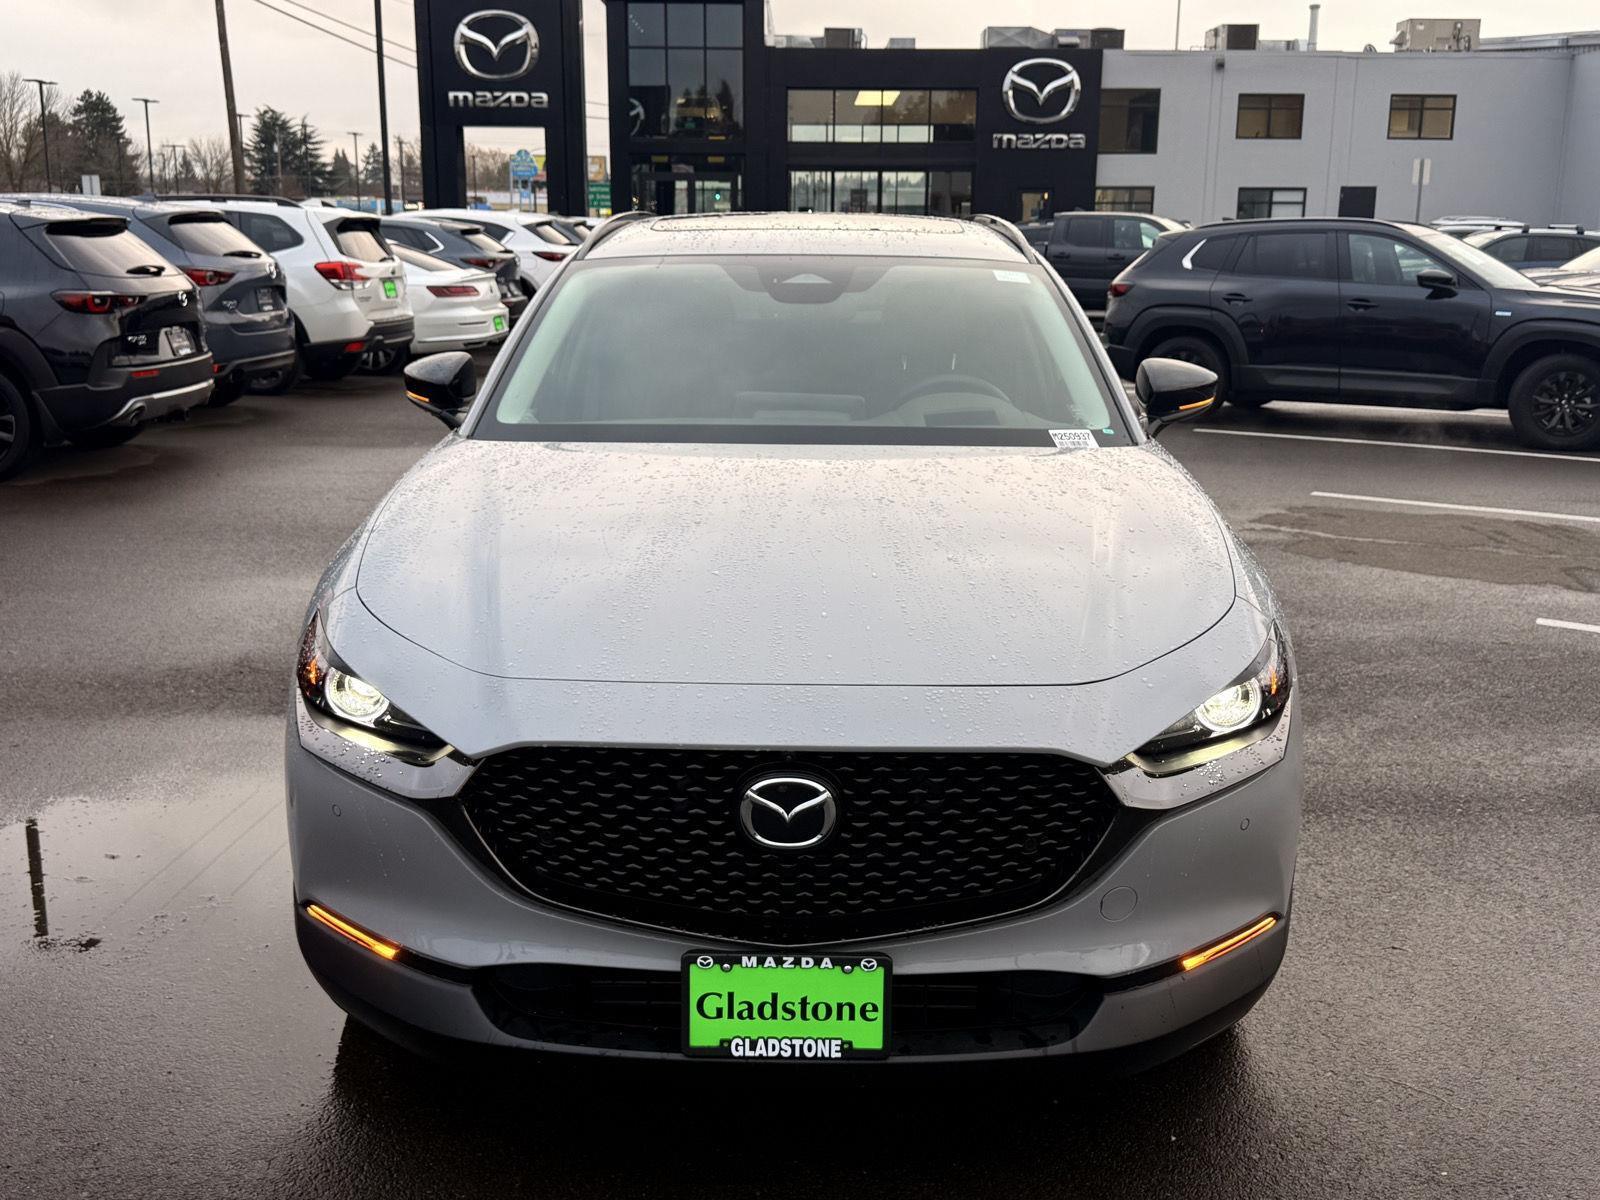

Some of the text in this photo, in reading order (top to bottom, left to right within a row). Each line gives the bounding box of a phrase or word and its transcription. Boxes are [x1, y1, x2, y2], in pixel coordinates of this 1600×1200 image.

[1051, 432, 1091, 441] M250937
[741, 956, 834, 969] MAZDA
[696, 991, 879, 1022] Gladstone
[730, 1037, 842, 1059] GLADSTONE
